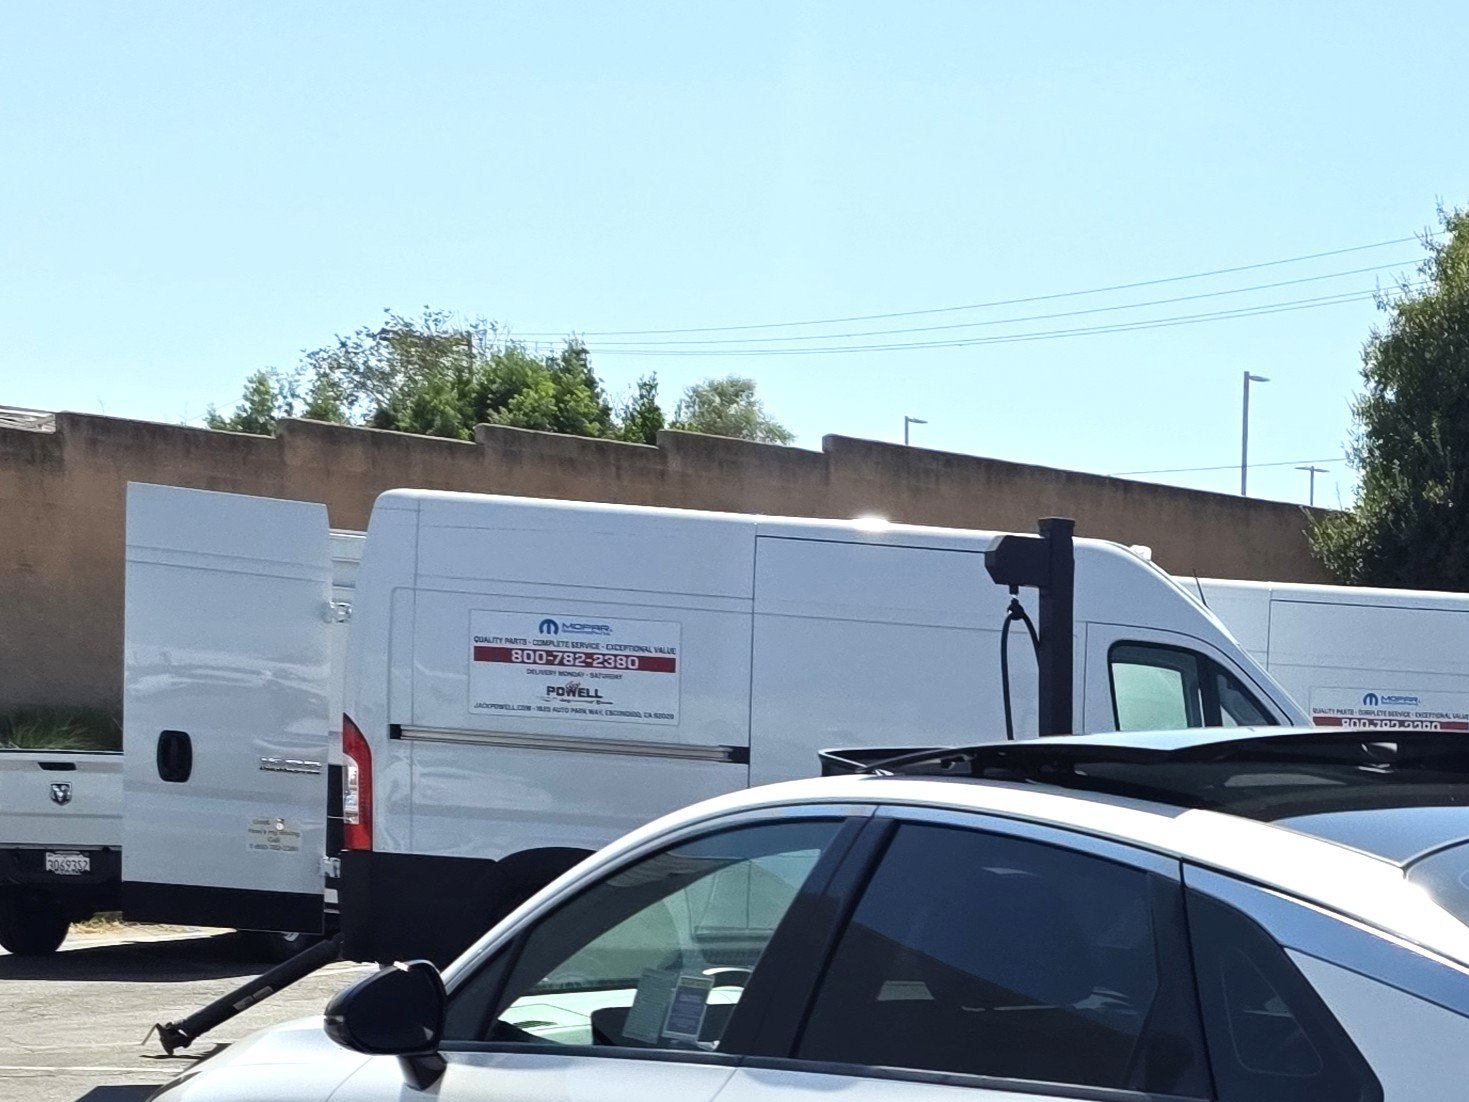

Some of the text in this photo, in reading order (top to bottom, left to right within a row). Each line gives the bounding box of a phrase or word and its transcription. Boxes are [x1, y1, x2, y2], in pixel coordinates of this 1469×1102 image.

[562, 621, 611, 632] MOPAR
[473, 635, 676, 655] QUALITY PARTS COMPLETE SERVICE EXCEPTIONAL VALUE
[511, 649, 639, 669] 800-782-2380
[546, 685, 603, 699] POWELL
